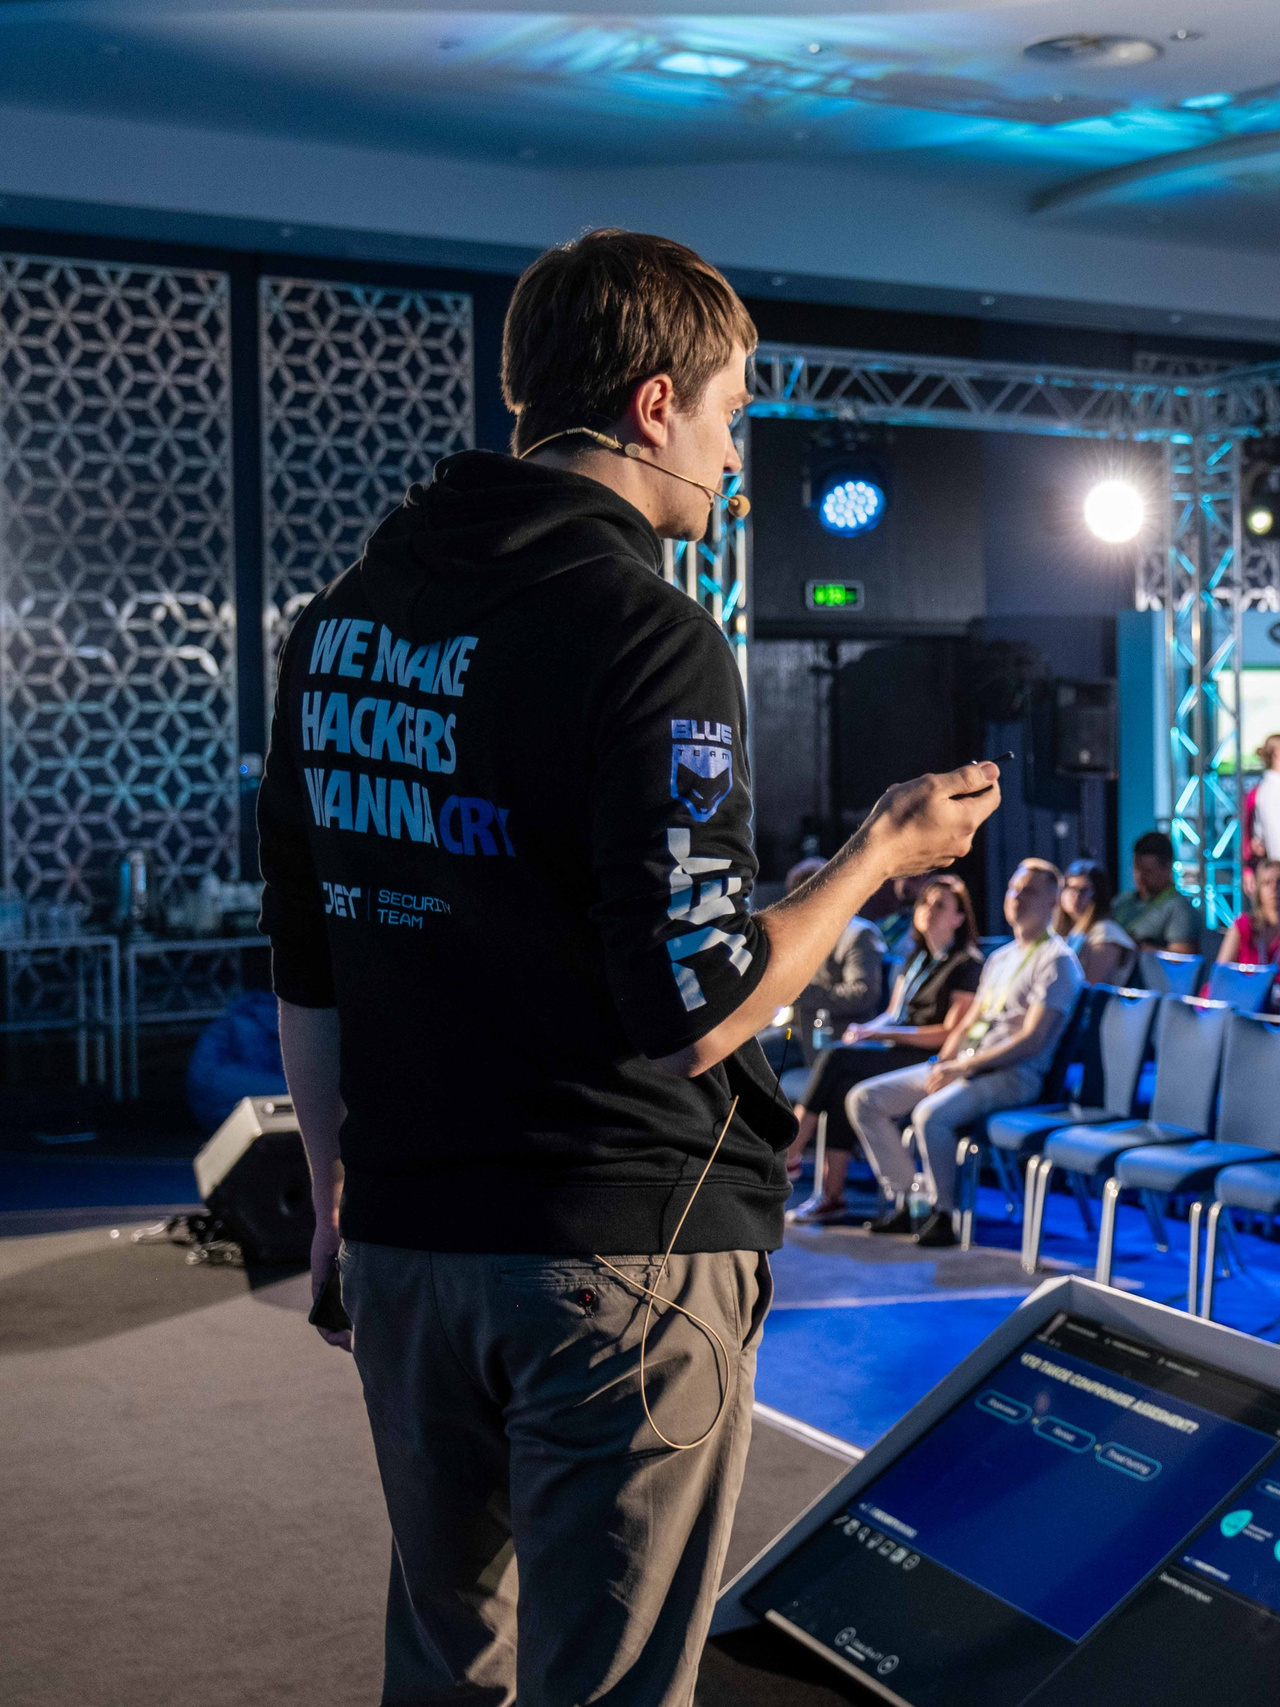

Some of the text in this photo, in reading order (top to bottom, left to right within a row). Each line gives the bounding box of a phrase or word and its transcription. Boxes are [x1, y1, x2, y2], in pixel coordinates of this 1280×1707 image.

[309, 618, 479, 697] WE MAKE
[301, 691, 457, 775] HACKERS
[671, 719, 733, 746] BLUE
[677, 748, 730, 761] TEAM
[439, 794, 517, 857] CRY
[322, 881, 361, 919] JET
[377, 909, 424, 929] TEAM
